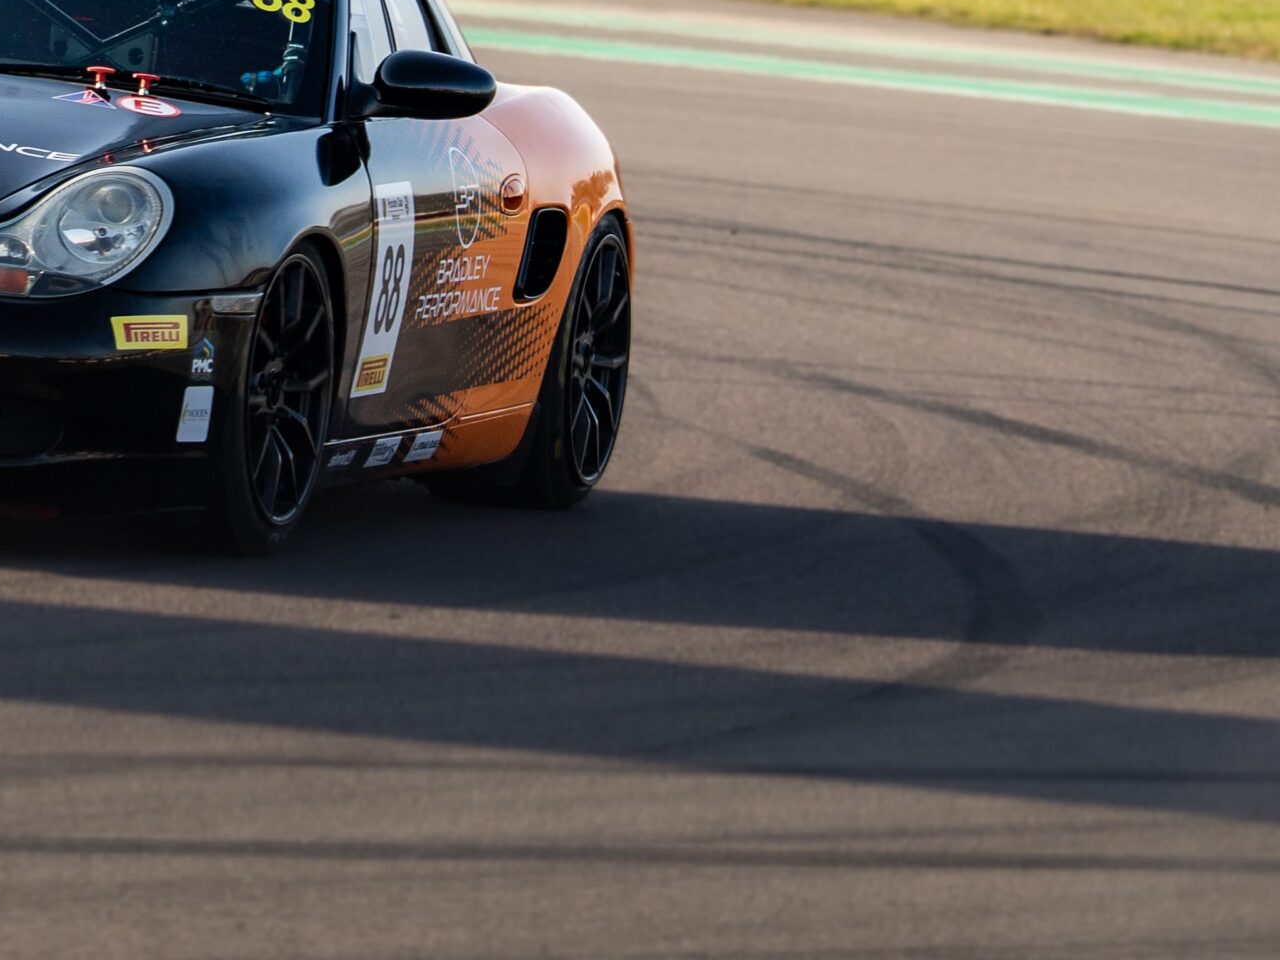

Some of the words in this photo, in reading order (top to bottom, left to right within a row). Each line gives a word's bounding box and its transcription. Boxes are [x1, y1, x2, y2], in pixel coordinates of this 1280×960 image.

[436, 254, 492, 285] BRADLEY
[374, 243, 405, 335] 88
[414, 287, 502, 320] PERFORMANCE
[123, 322, 180, 343] PIRELLI
[192, 359, 214, 373] PMC
[357, 357, 388, 388] PIRELLI
